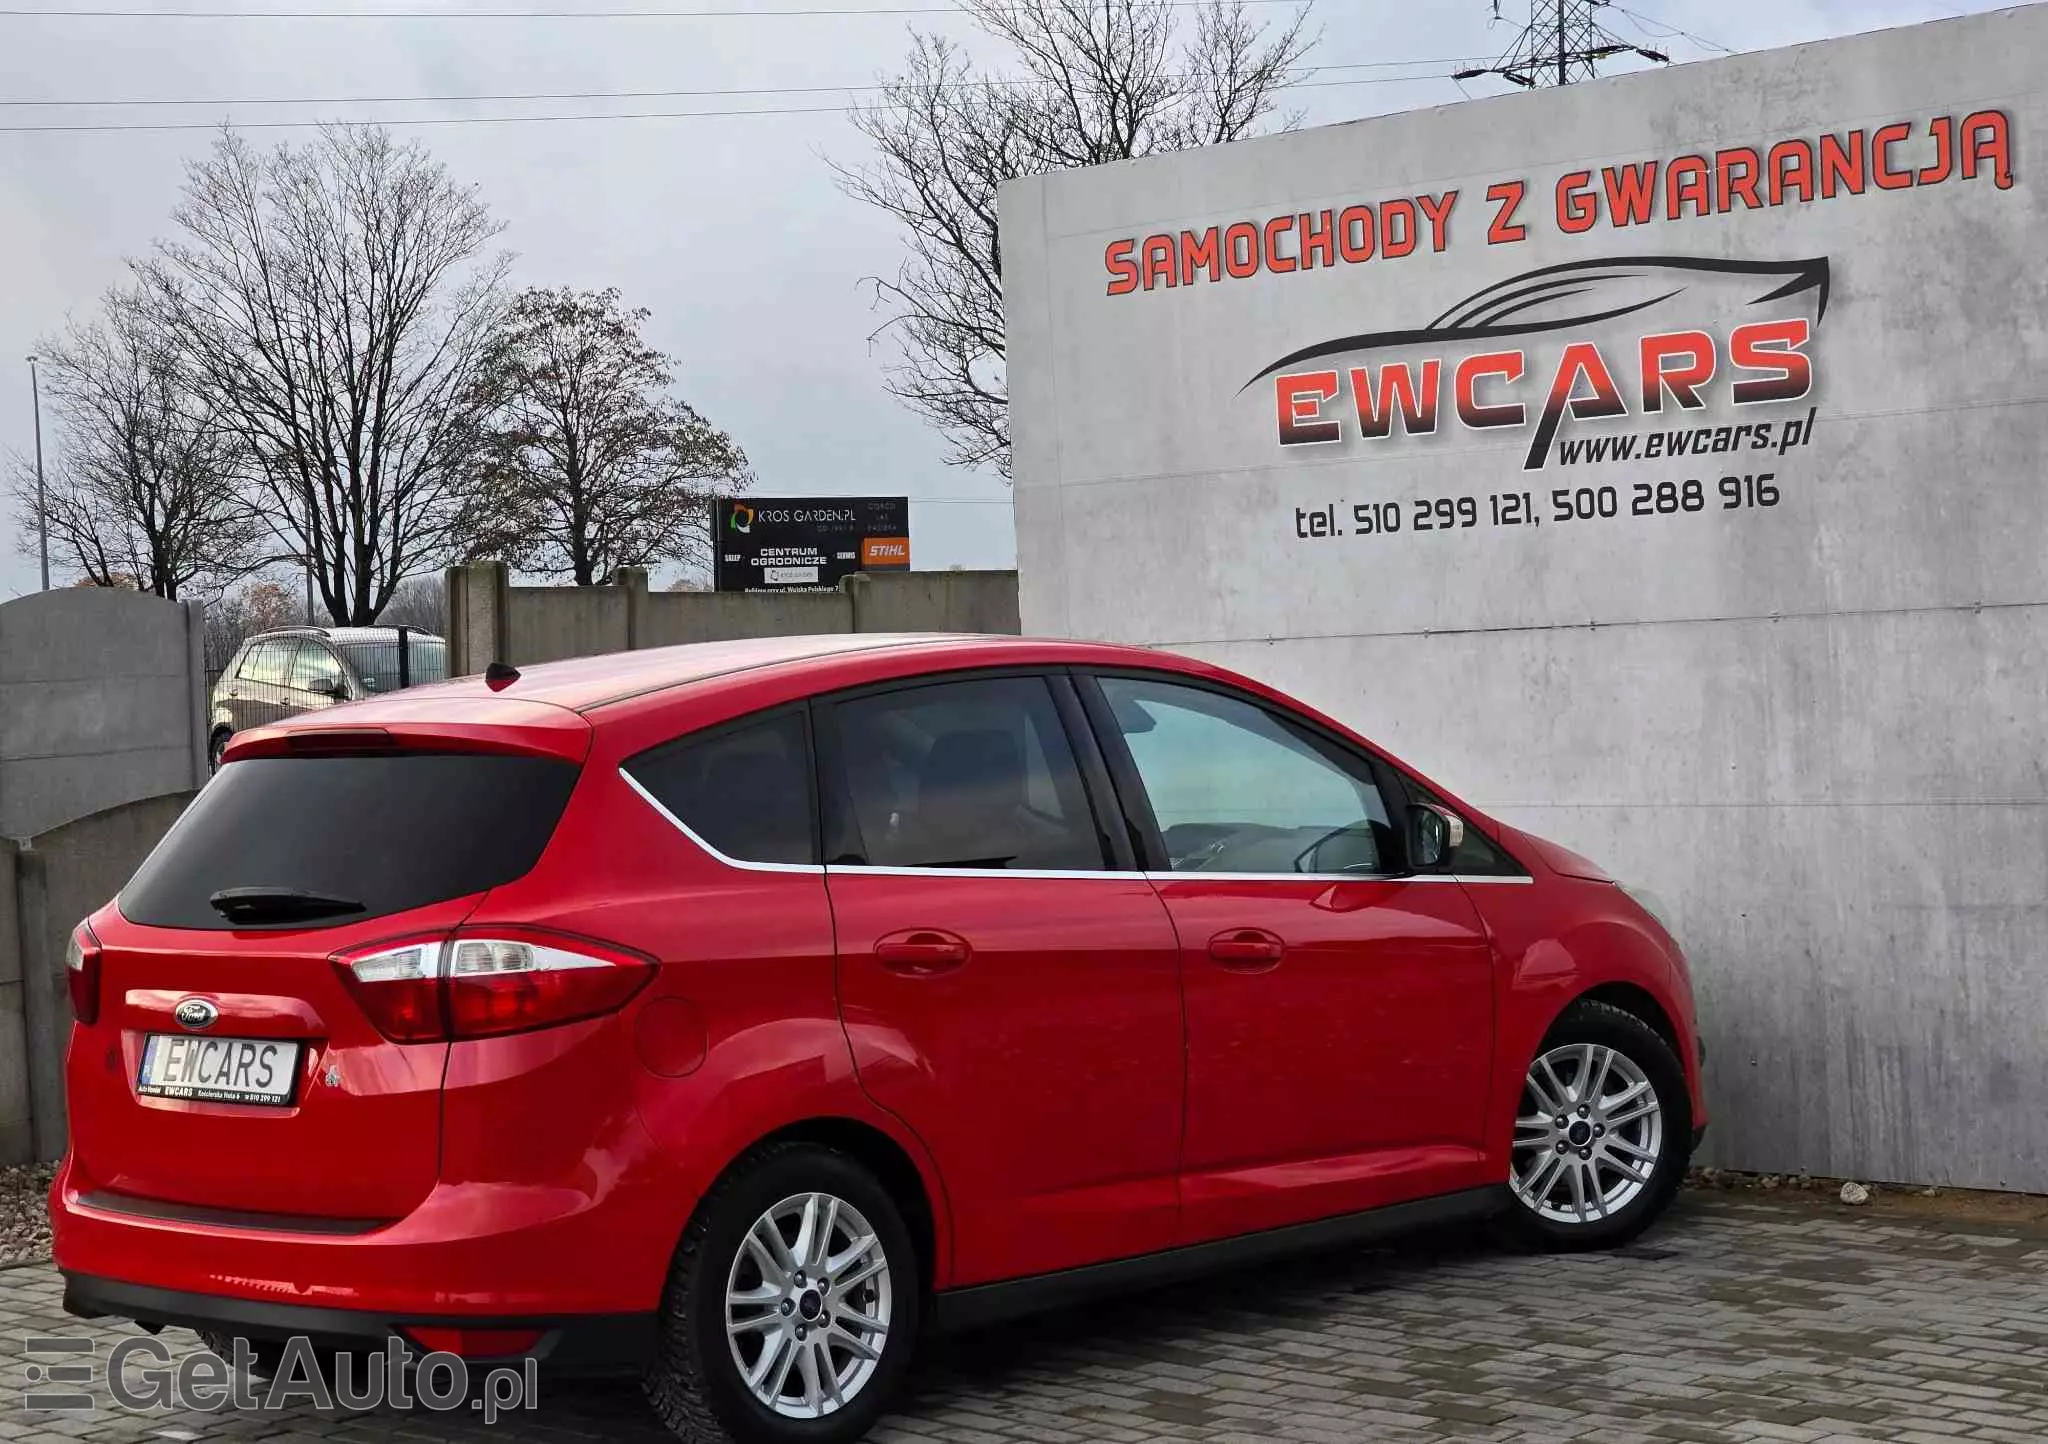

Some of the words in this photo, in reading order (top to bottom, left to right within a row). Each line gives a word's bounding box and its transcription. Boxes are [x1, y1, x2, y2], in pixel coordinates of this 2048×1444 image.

[1107, 193, 1456, 295] SAMOCHODY
[1487, 183, 1525, 243] Z
[1556, 110, 2013, 234] GWARANCJĄ
[1274, 318, 1813, 471] EWCARS
[1559, 406, 1817, 466] www.ewcars.pl
[1296, 505, 1343, 538] tel.
[1354, 503, 1401, 535] 510
[1414, 497, 1477, 530] 299
[1490, 493, 1541, 531] 121,
[1552, 487, 1618, 521] 500
[1632, 480, 1705, 516] 288
[1718, 474, 1780, 510] 916
[758, 509, 790, 523] KROS
[794, 508, 857, 522] GARDEN.PL
[760, 547, 818, 557] CENTRUM
[869, 544, 906, 556] STIHL
[751, 557, 828, 566] OGRODNICZE
[181, 1005, 207, 1022] Ford
[163, 1038, 278, 1089] EWCARS
[165, 1086, 193, 1097] EWCARS
